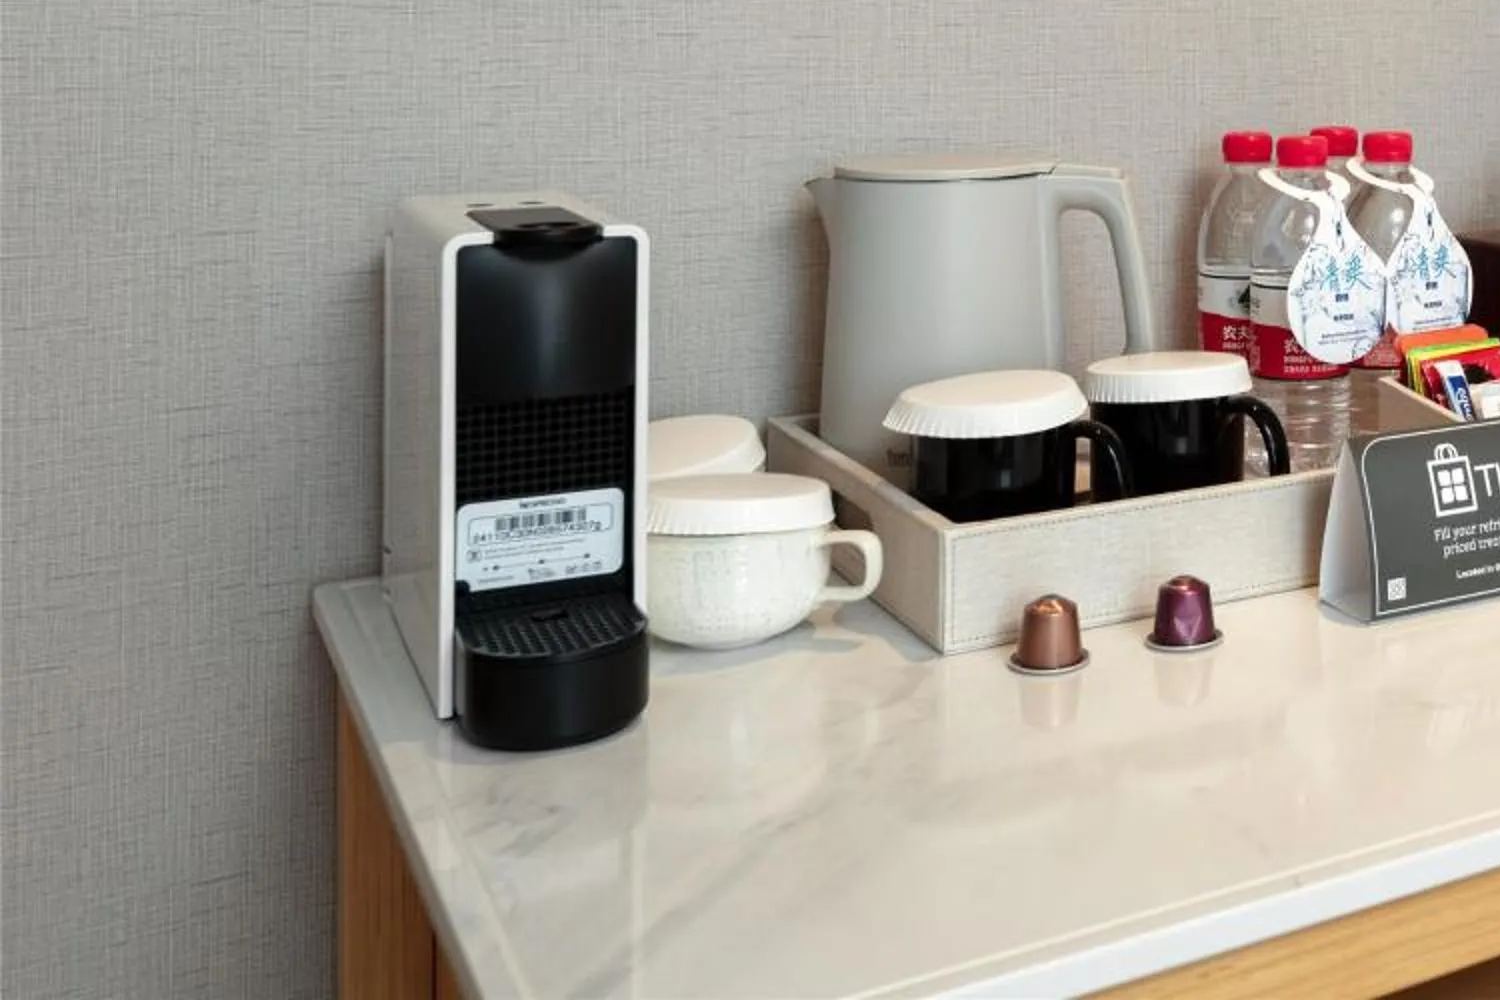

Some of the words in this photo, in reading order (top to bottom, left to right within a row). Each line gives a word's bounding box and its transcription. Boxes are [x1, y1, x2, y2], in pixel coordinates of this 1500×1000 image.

[1434, 526, 1451, 542] Fill
[1452, 525, 1477, 541] your
[1443, 539, 1477, 559] priced
